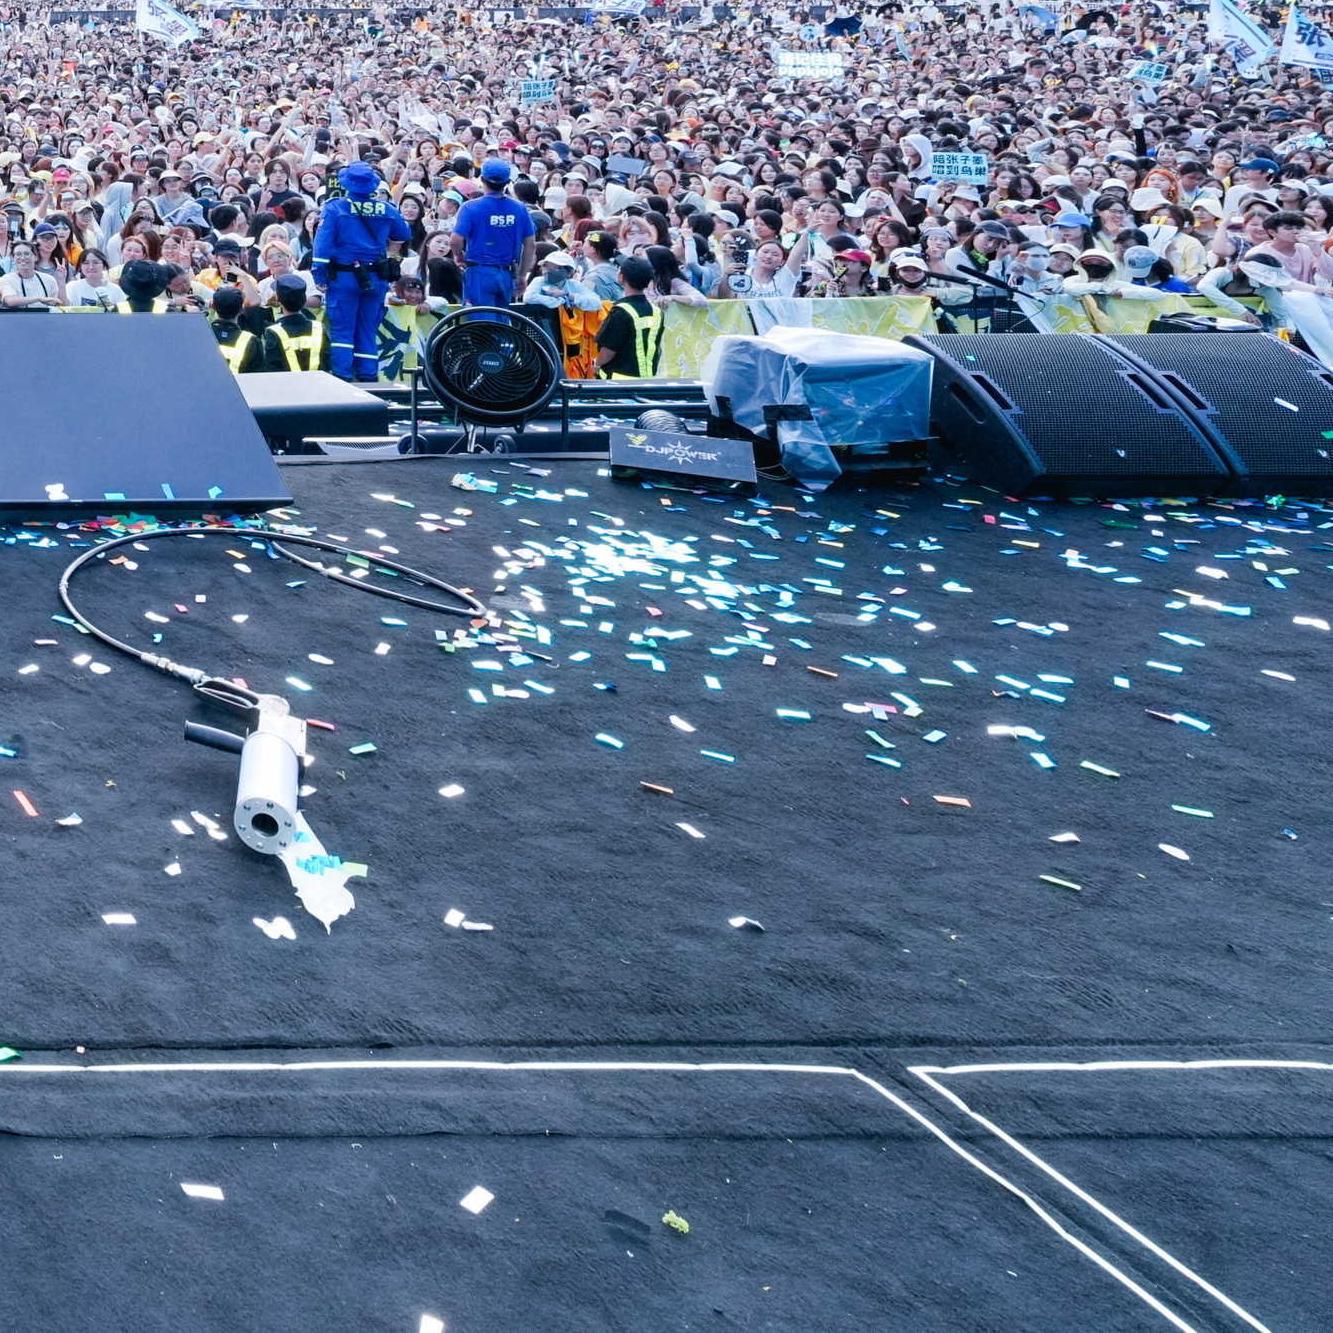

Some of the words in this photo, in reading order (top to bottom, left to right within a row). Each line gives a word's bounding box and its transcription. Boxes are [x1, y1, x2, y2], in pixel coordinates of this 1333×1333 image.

[778, 52, 843, 66] 请记住我
[778, 67, 844, 79] pkpkjojo
[933, 155, 983, 165] 陪张子墨
[932, 165, 987, 176] 唱到鸟巢
[350, 201, 386, 215] BSR
[489, 214, 515, 225] BSR
